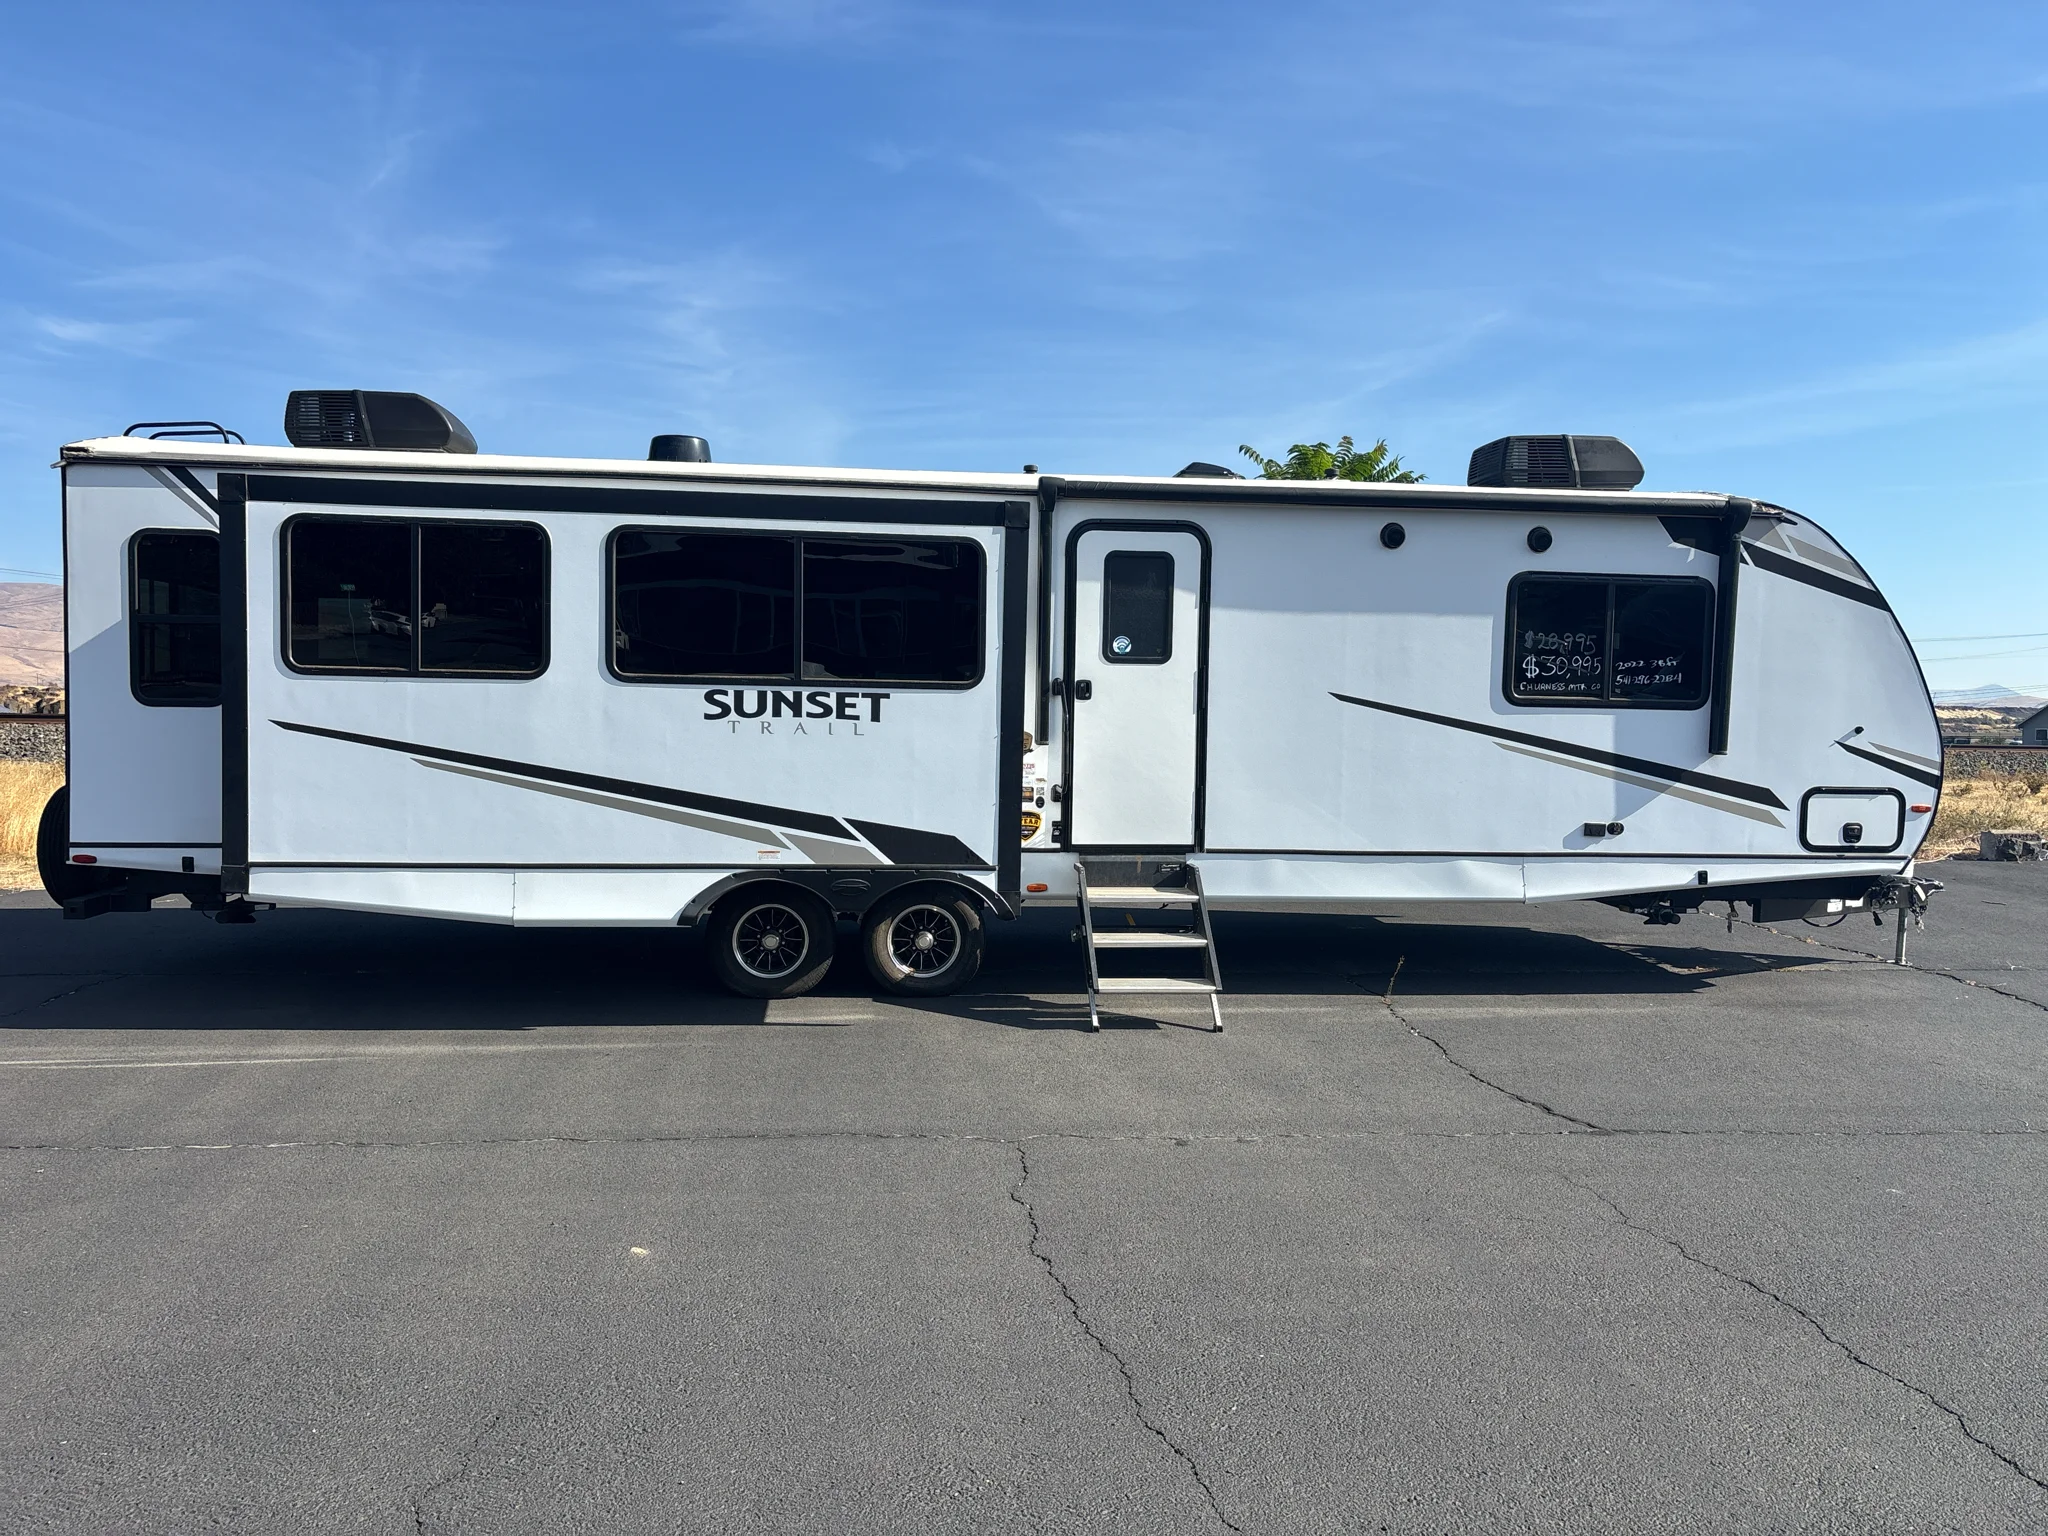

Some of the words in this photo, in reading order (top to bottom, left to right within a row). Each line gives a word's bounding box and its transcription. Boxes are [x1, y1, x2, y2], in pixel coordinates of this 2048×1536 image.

[1522, 654, 1602, 679] $30,995
[1615, 660, 1646, 670] 2022
[704, 689, 890, 722] SUNSET
[727, 720, 865, 736] TRAIL
